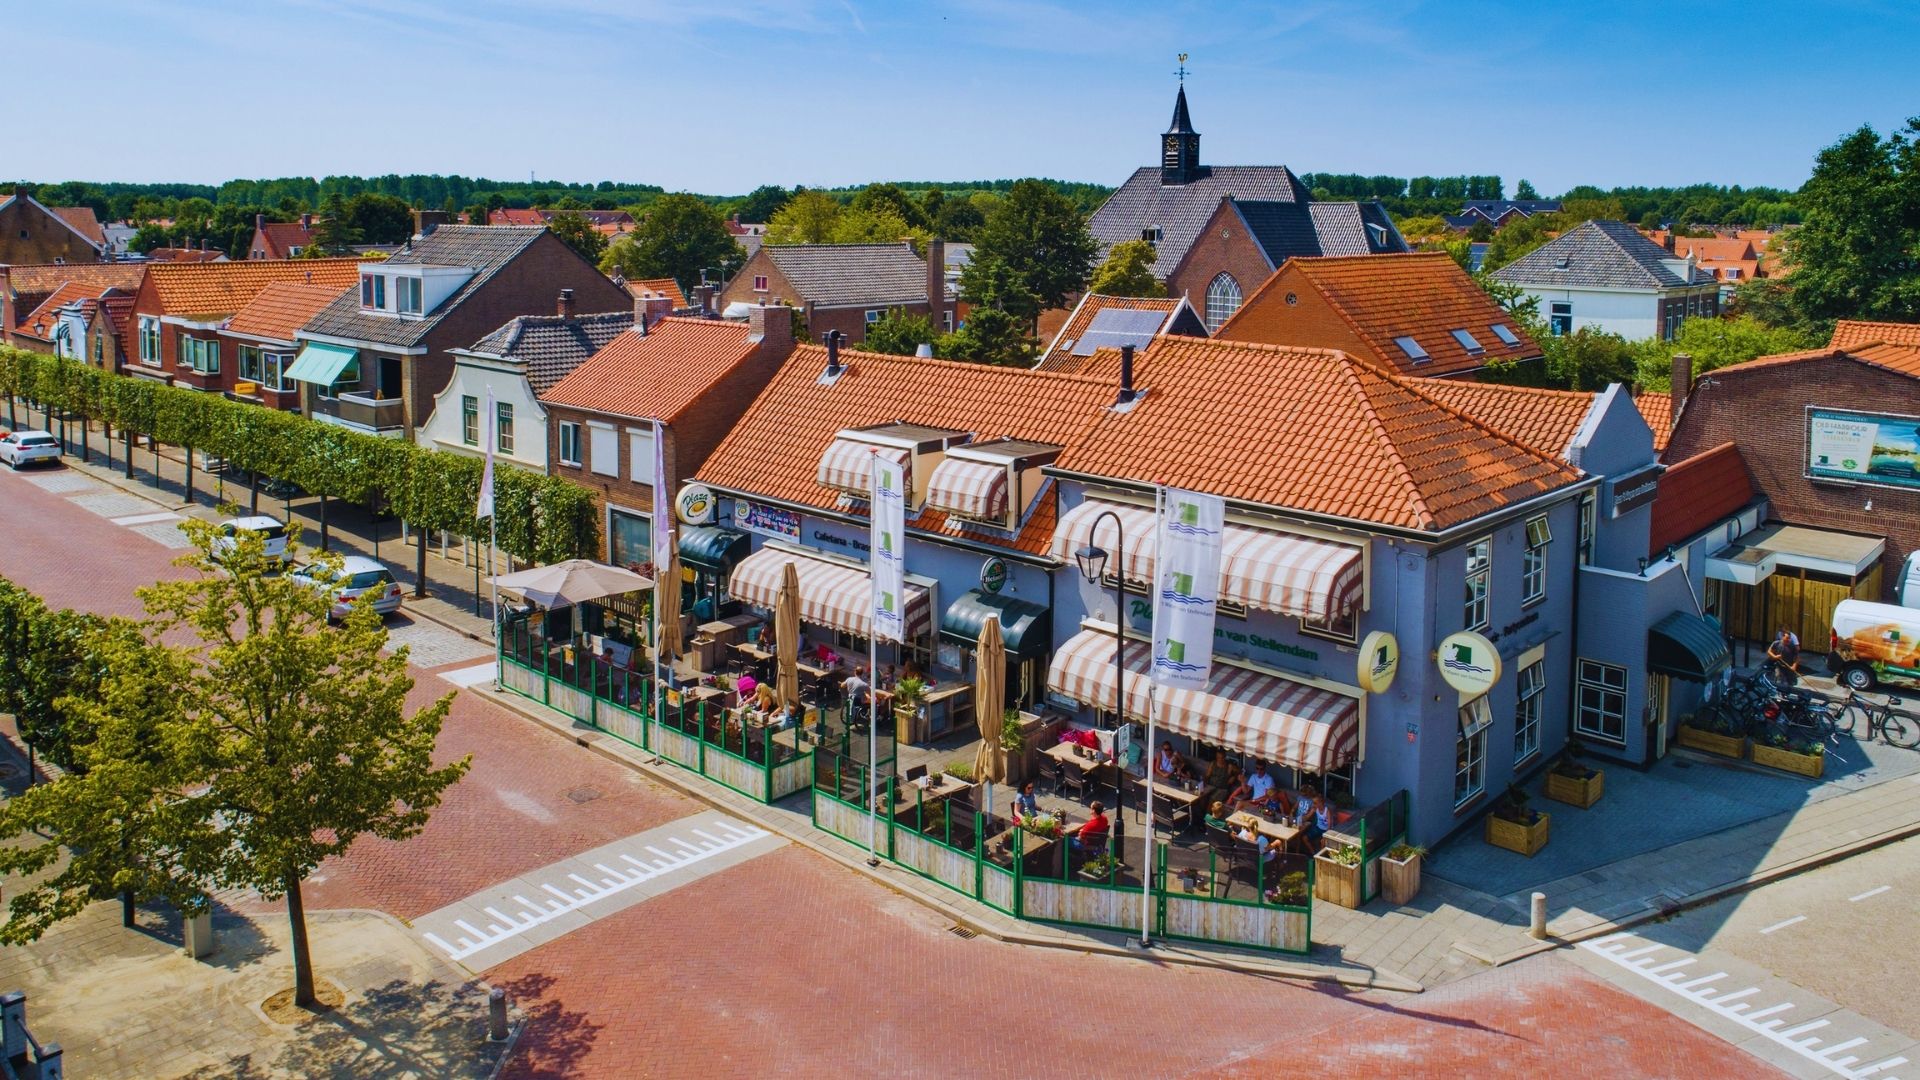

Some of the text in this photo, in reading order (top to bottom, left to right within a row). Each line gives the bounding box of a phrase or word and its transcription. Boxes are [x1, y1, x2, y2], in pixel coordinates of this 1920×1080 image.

[682, 493, 709, 507] Plaza
[853, 539, 871, 553] Bras
[1226, 631, 1247, 643] van
[1249, 634, 1318, 660] Stellendam
